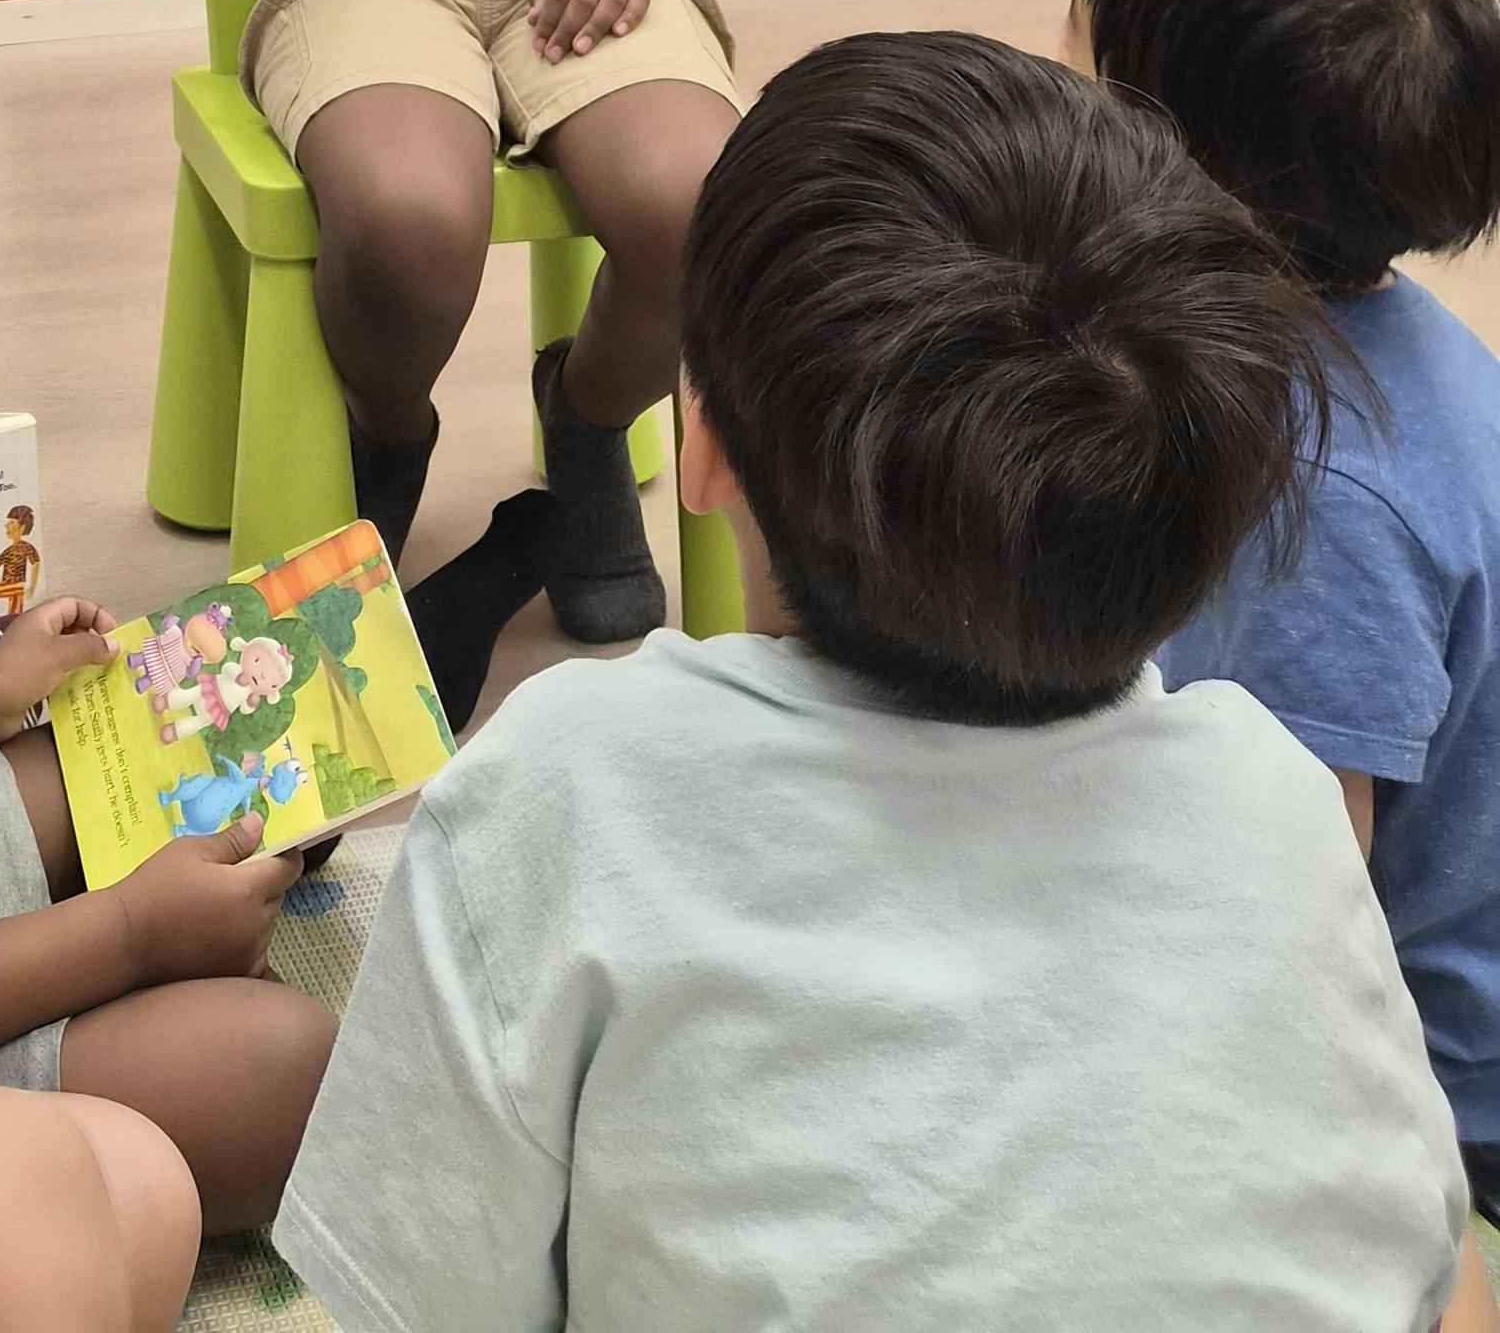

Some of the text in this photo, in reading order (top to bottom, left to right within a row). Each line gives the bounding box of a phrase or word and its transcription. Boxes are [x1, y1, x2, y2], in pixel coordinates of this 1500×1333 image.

[83, 680, 96, 712] When
[72, 706, 82, 722] for
[104, 704, 121, 746] dragons
[76, 720, 88, 749] help.
[109, 794, 118, 808] he
[112, 810, 132, 848] doesn't
